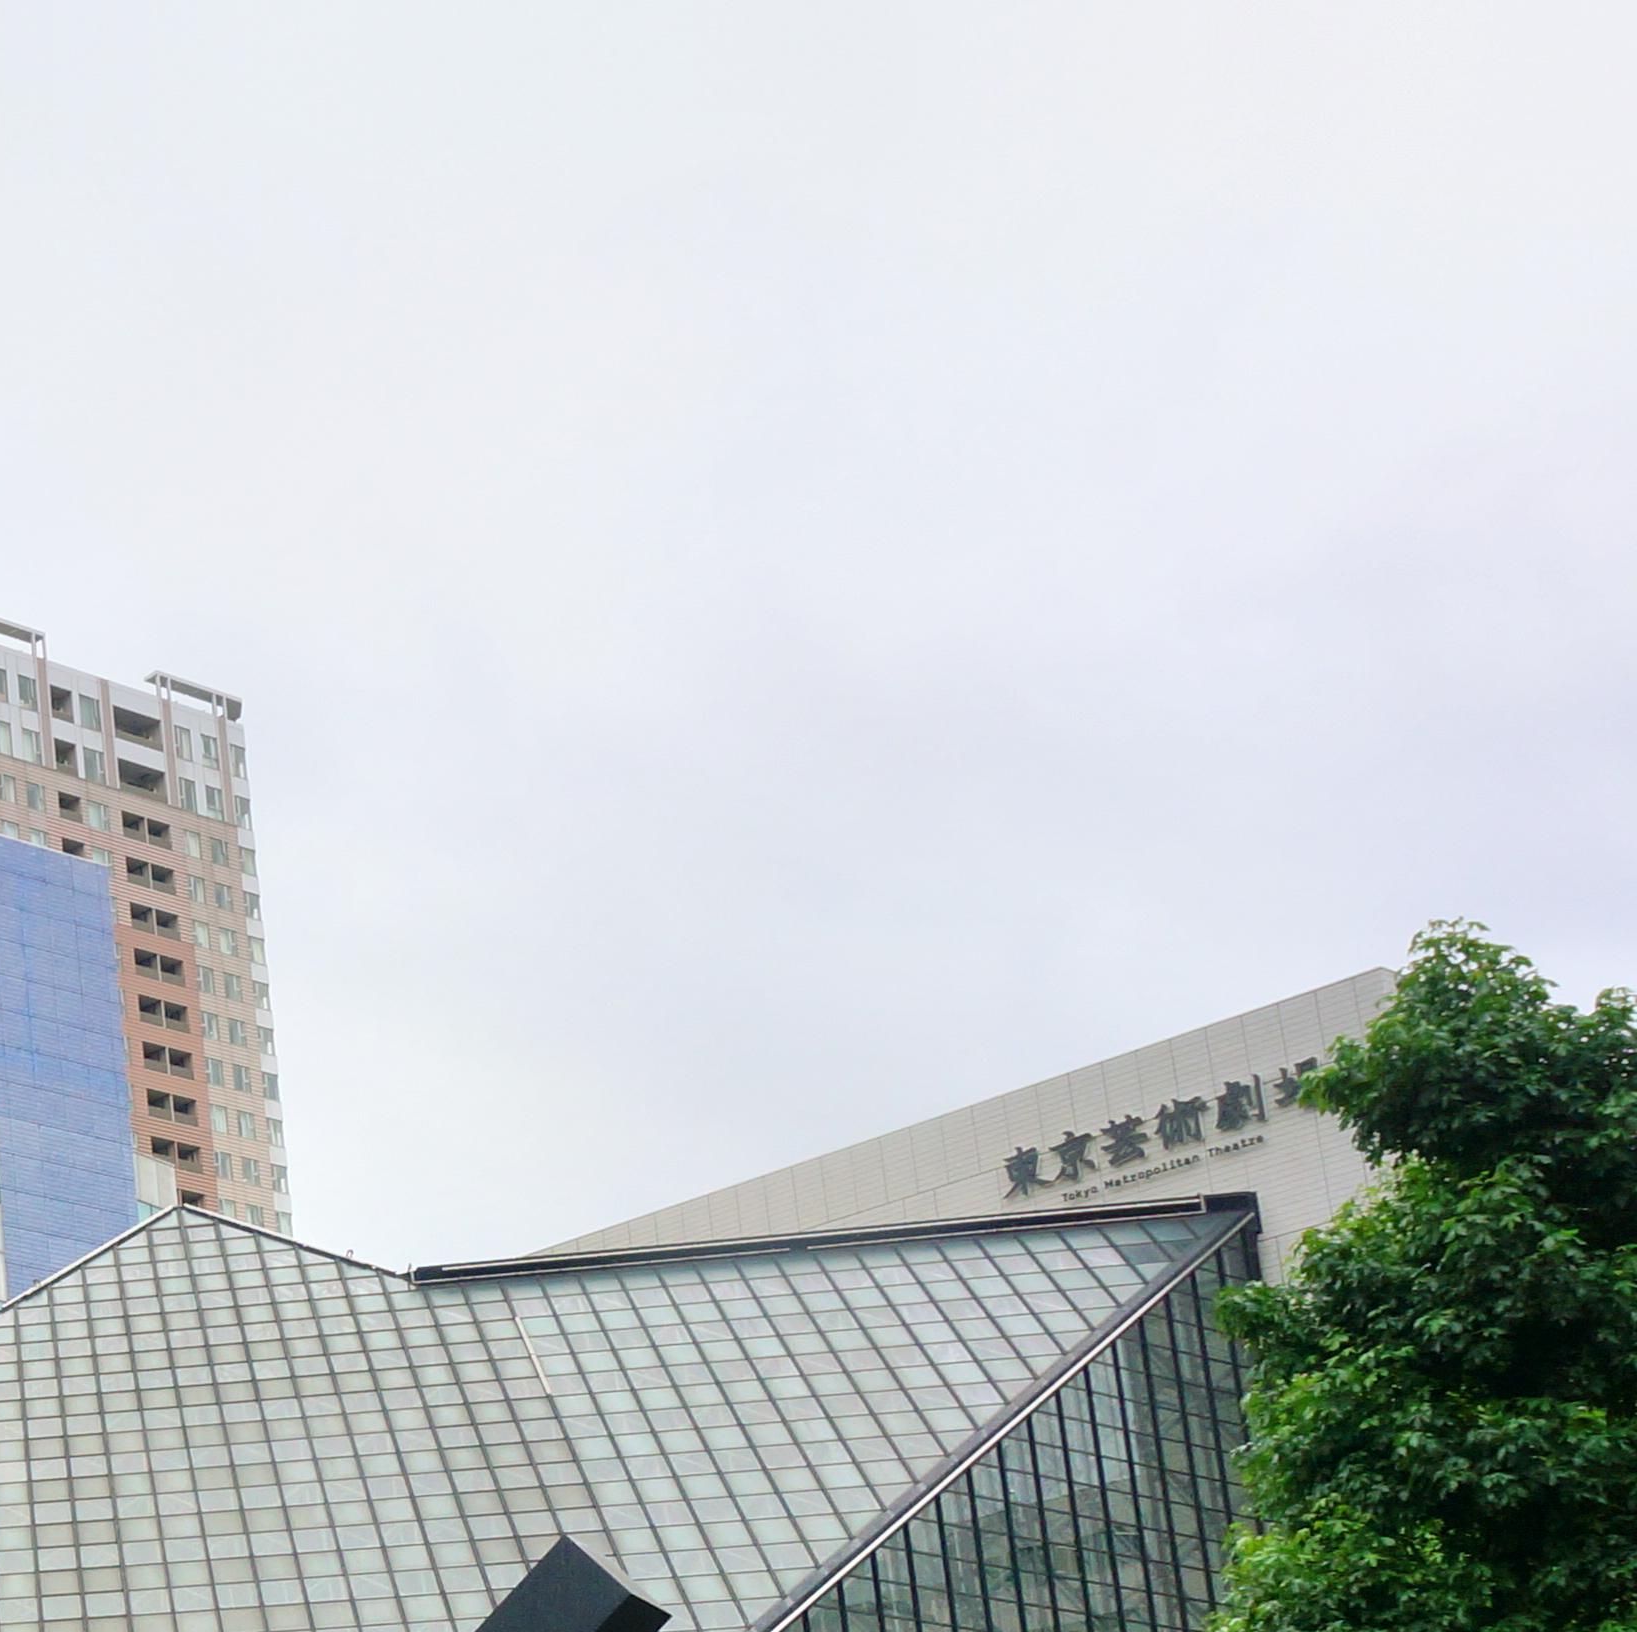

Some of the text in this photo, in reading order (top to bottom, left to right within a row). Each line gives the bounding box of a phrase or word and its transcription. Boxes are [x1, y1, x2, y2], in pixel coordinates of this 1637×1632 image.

[1061, 1133, 1264, 1203] Tokyo Metropolitan Theatre
